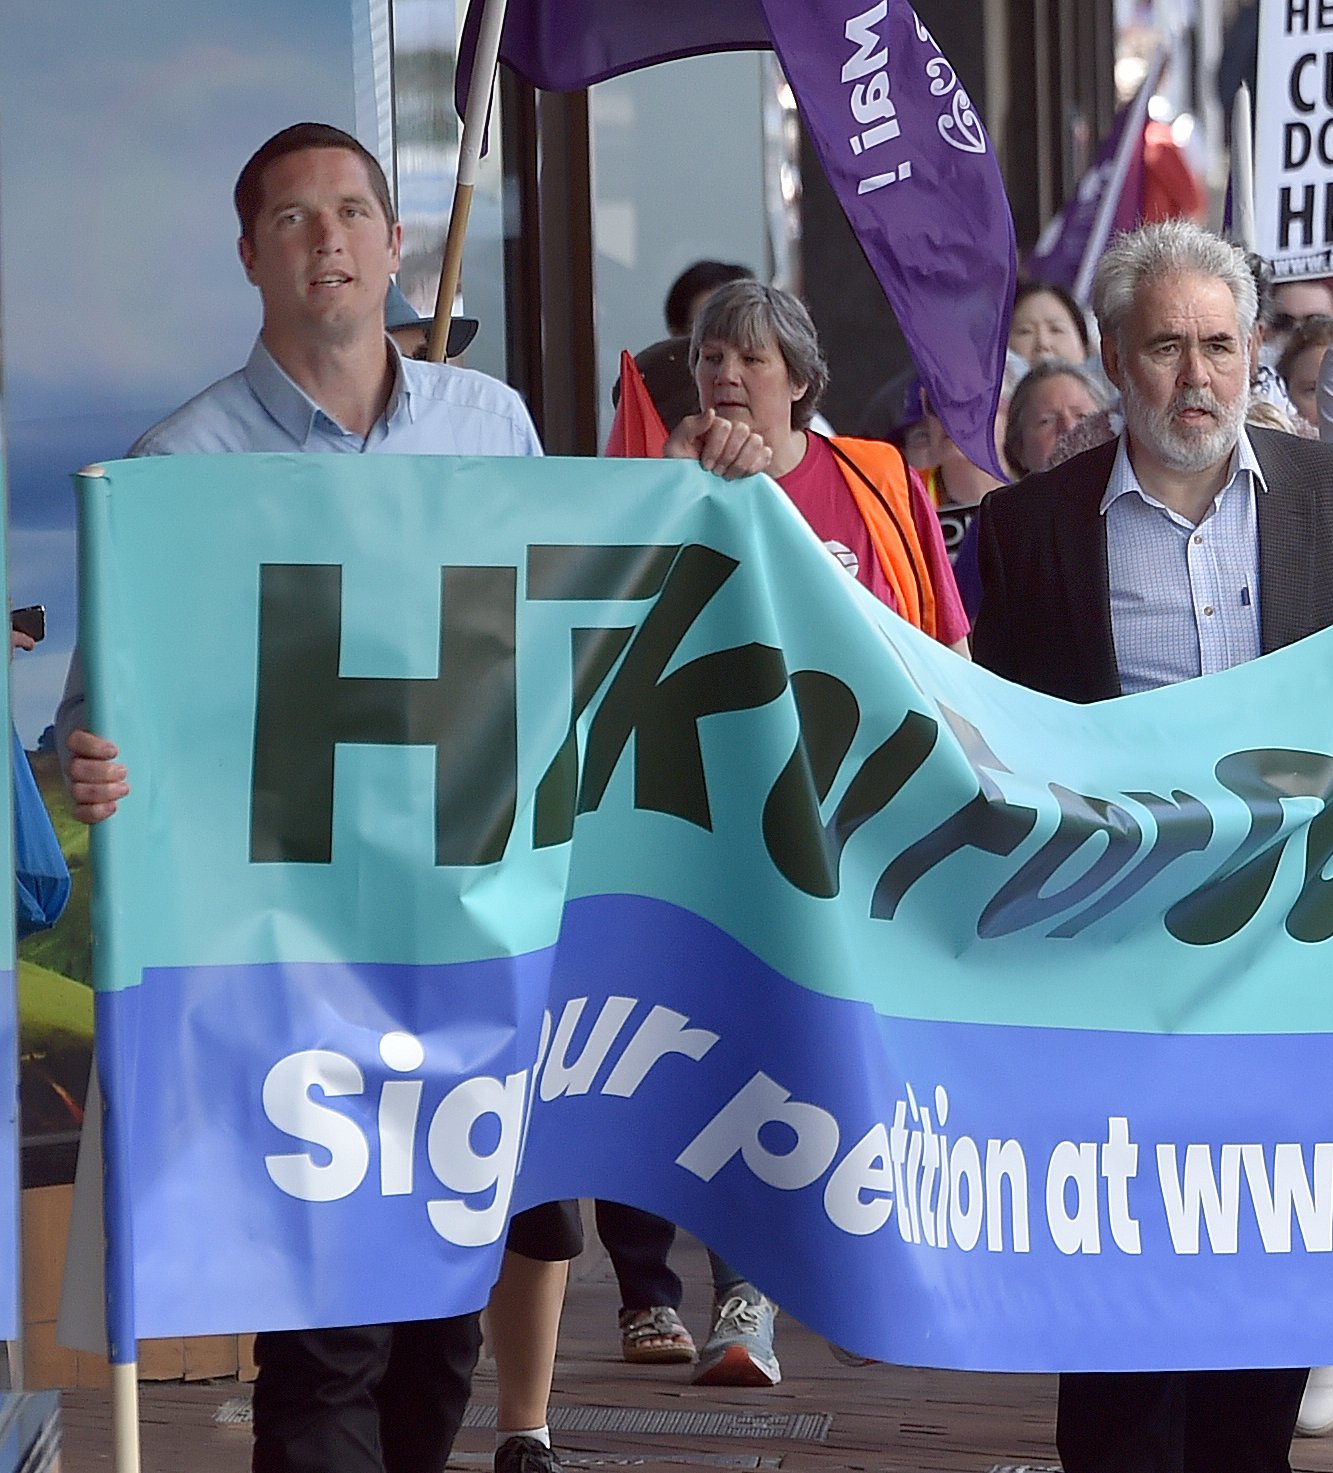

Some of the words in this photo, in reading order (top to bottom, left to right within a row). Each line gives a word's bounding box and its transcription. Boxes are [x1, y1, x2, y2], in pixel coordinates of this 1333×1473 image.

[263, 1031, 538, 1248] Sig
[674, 1070, 1031, 1253] petition
[1045, 1116, 1142, 1256] at
